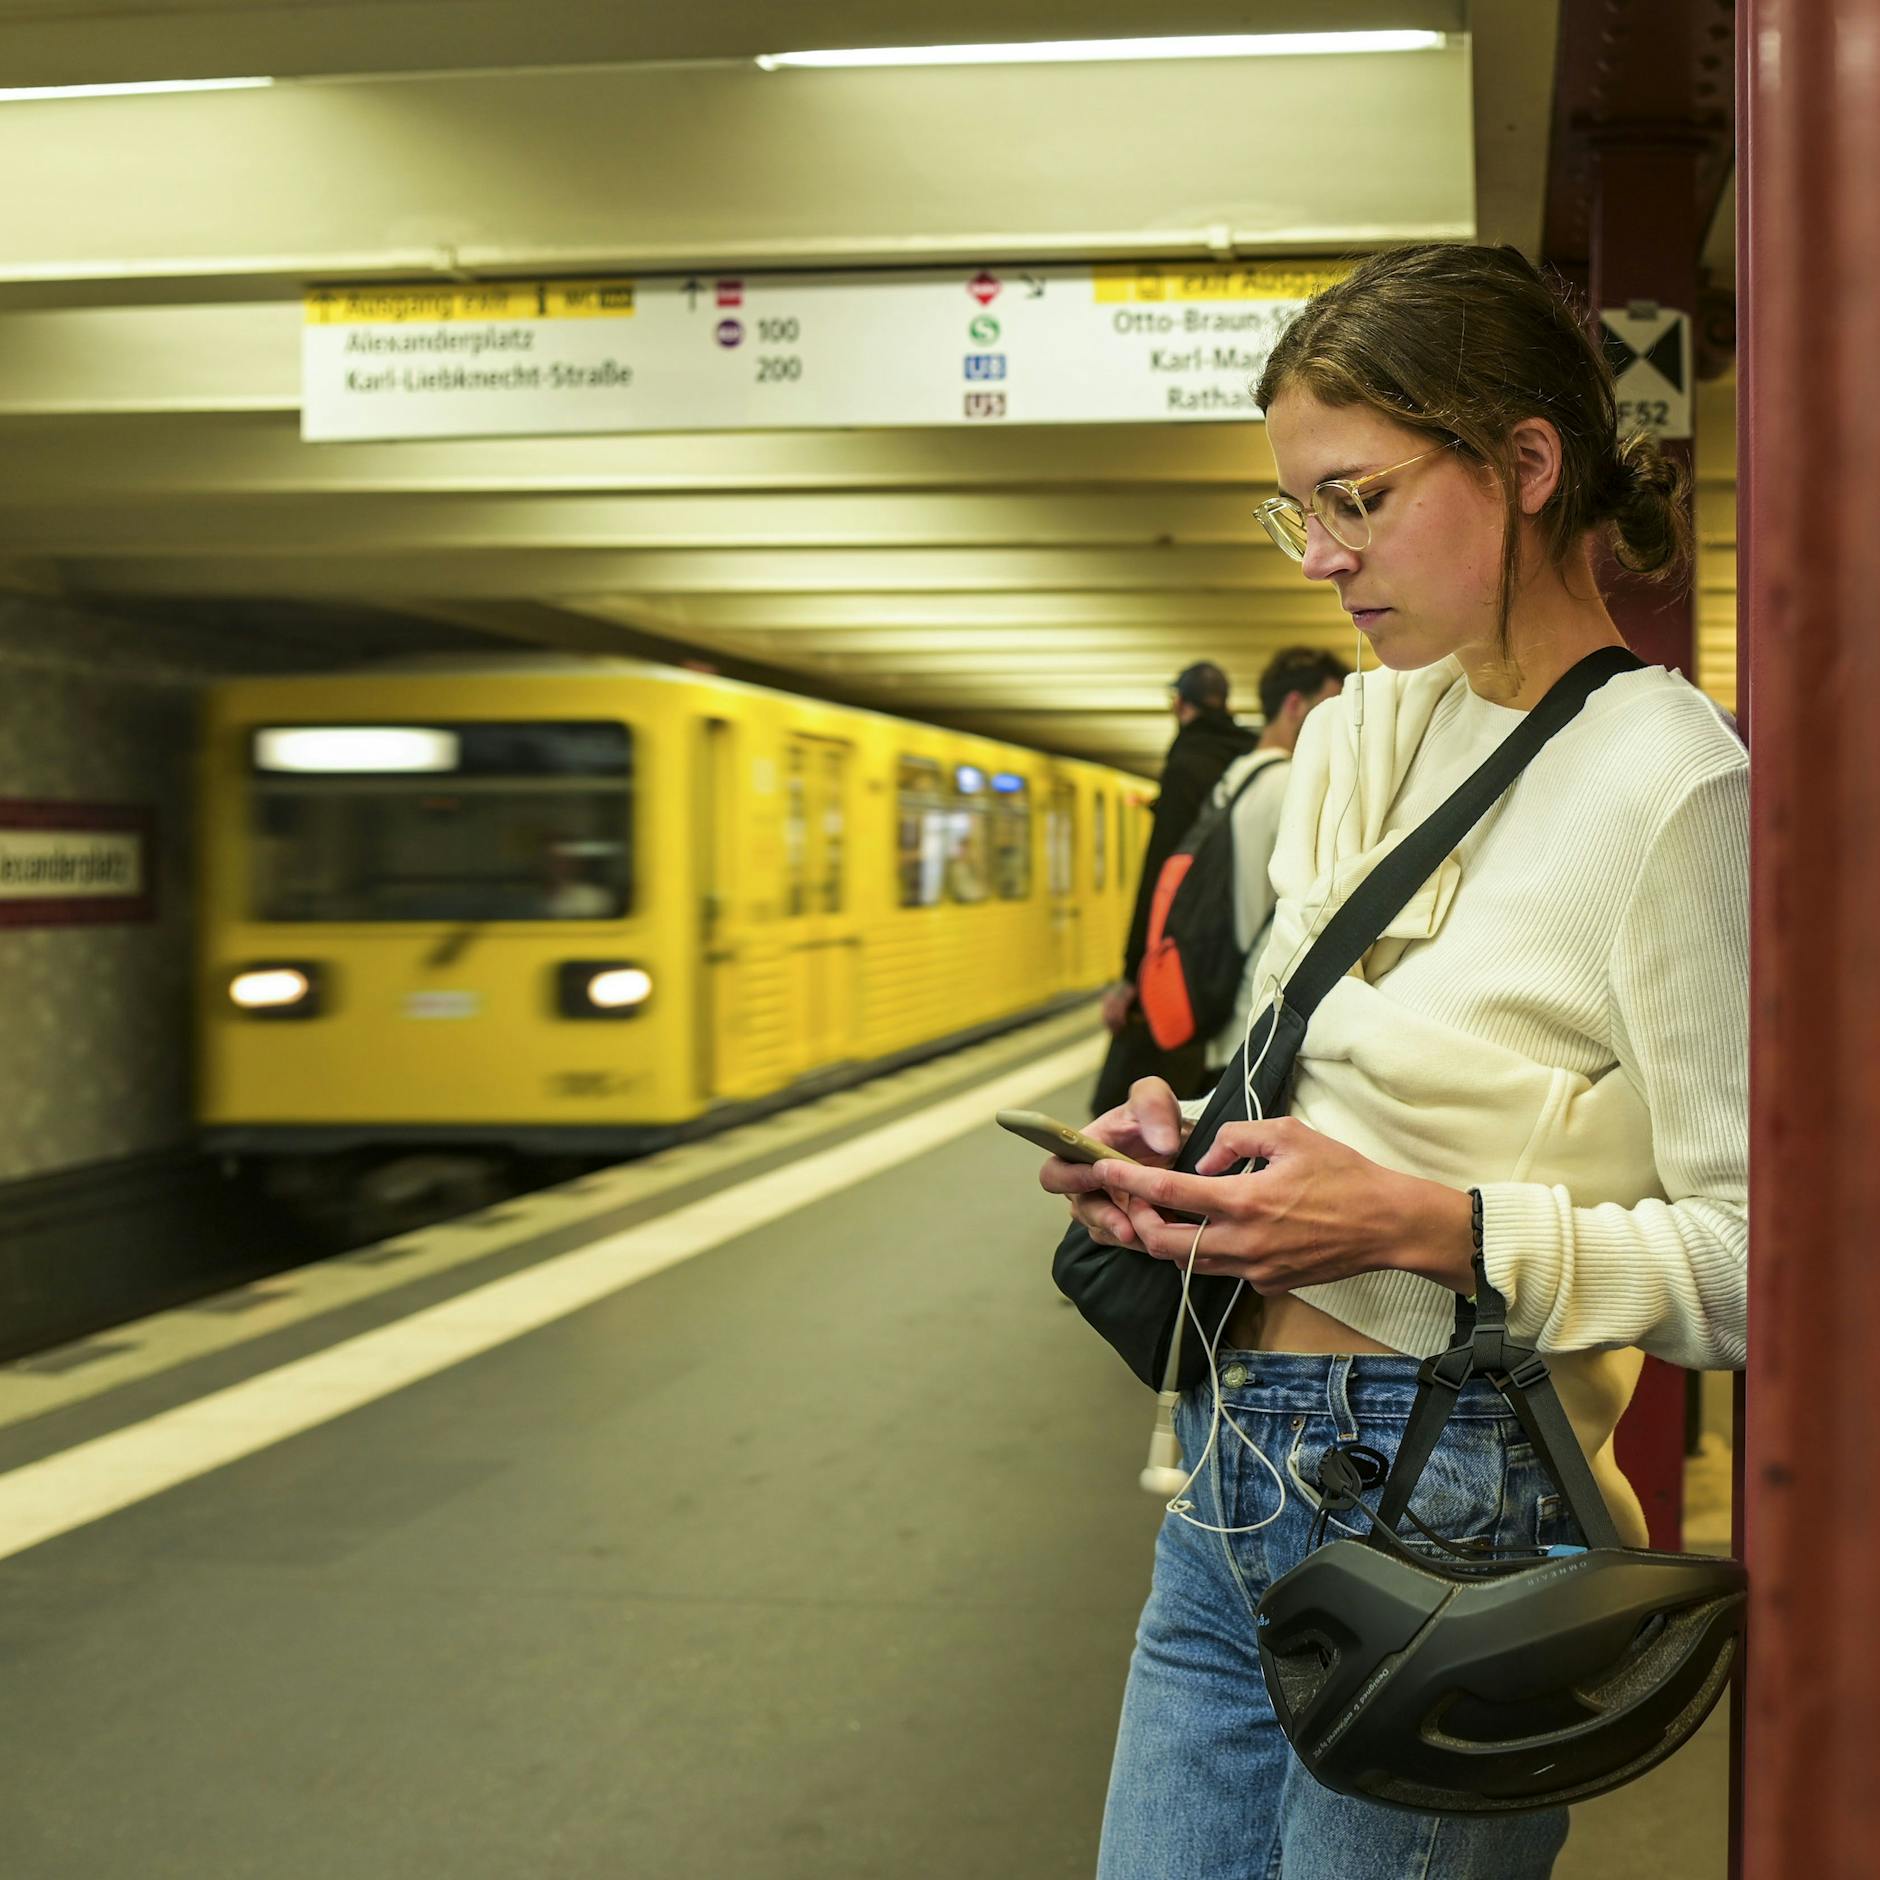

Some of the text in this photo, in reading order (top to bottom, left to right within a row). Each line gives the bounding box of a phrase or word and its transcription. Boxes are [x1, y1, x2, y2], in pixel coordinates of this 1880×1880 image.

[346, 326, 535, 357] Alexanderplatz
[757, 319, 800, 342] 100
[346, 361, 633, 391] Karl-Liebknecht-Straße
[756, 355, 802, 381] 200
[1617, 401, 1669, 426] F52
[1359, 1668, 1390, 1705] Designed
